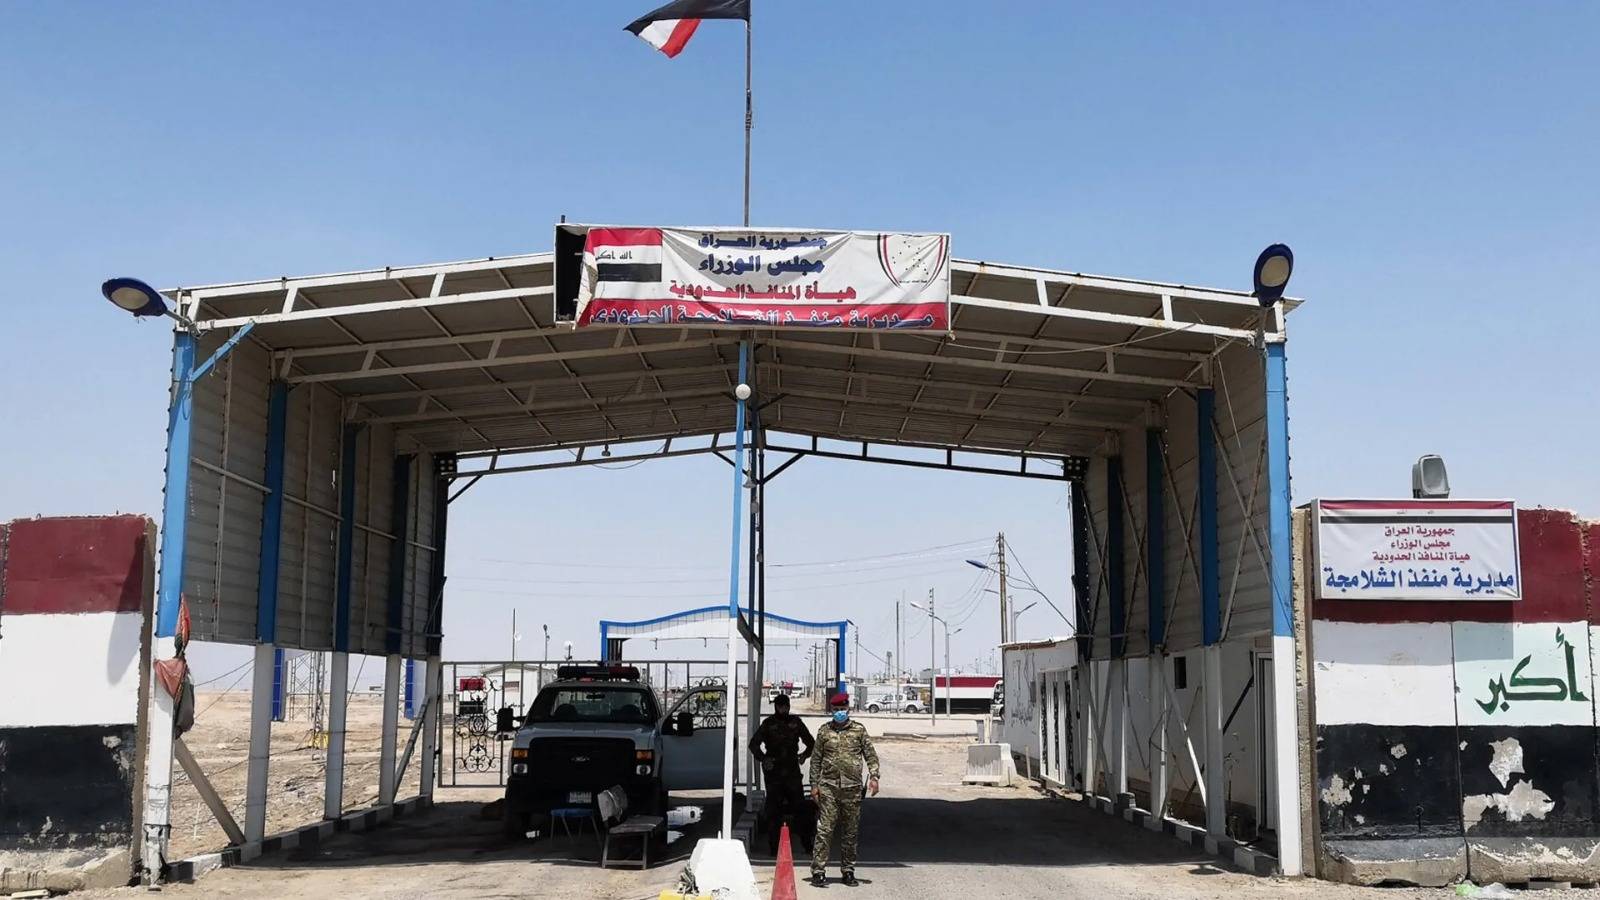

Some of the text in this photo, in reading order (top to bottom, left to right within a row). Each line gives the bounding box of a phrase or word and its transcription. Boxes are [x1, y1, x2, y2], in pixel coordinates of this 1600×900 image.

[698, 233, 827, 250] جمهورية العراق
[698, 253, 825, 276] مجلس الوزراء
[670, 280, 746, 300] الحدودية
[805, 281, 856, 303] هيأة
[783, 310, 843, 327] منفذ
[1384, 525, 1455, 538] جمهورية العراق
[1390, 539, 1451, 550] مجلس الوزراء
[1372, 551, 1471, 563] هيأة المنافذ الحدودية
[1323, 566, 1515, 594] مديرية منفذ الشلامجة
